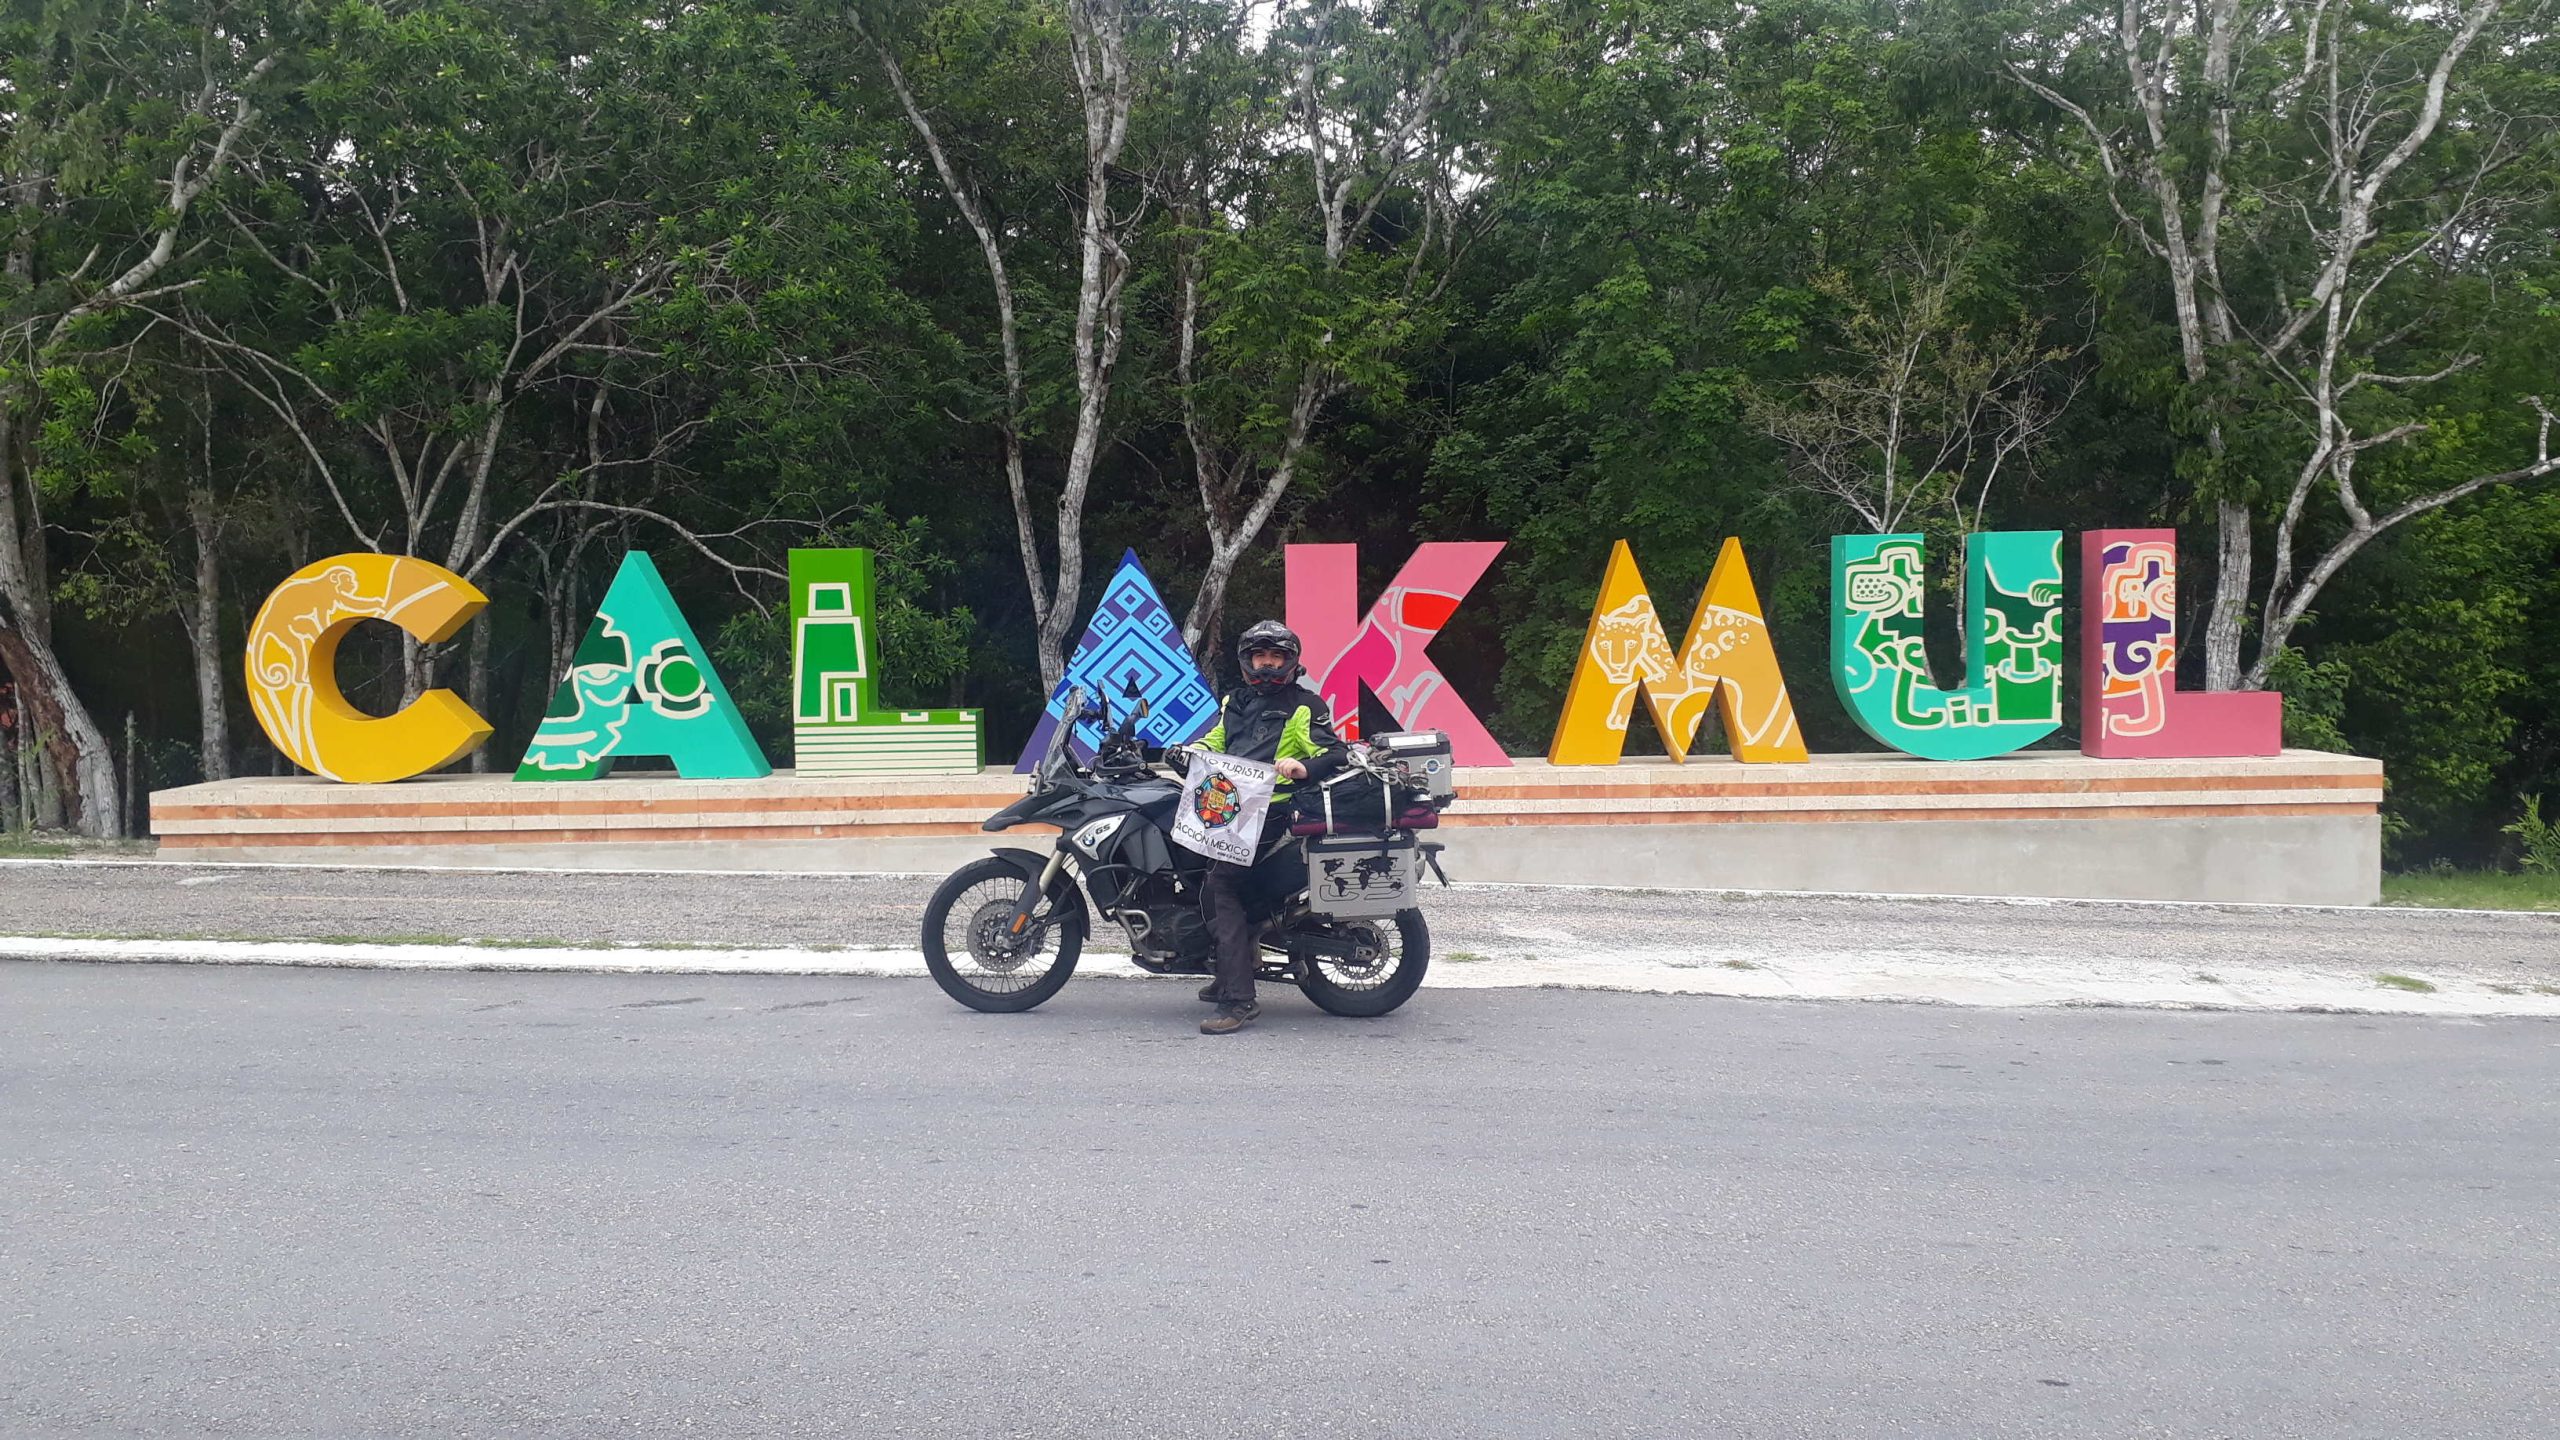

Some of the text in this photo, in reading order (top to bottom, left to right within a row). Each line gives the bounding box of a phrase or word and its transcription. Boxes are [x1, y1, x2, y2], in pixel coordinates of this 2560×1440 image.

[244, 527, 2282, 783] CALAKMUL
[1222, 761, 1265, 780] TURISTA
[1095, 823, 1111, 835] GS
[1175, 822, 1209, 846] ACCIÓN
[1210, 840, 1250, 857] MÉXICO
